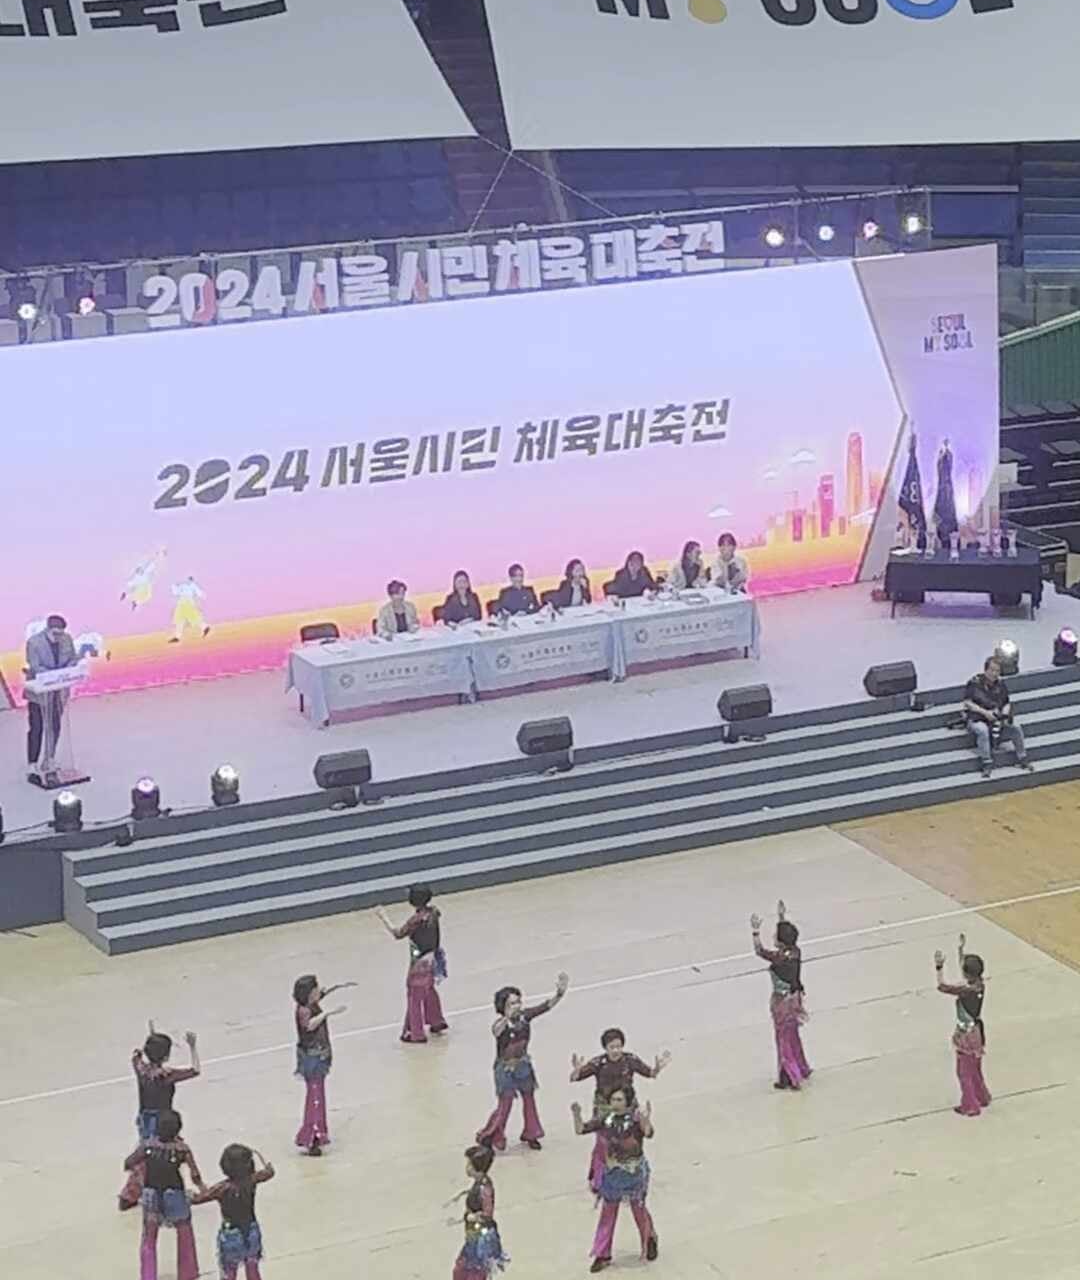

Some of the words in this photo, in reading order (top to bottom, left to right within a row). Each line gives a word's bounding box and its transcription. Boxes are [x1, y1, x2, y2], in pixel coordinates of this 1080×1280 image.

[143, 265, 286, 328] 2024
[154, 448, 311, 510] 2024
[320, 425, 501, 489] 서울시민
[513, 398, 731, 464] 체육대축전
